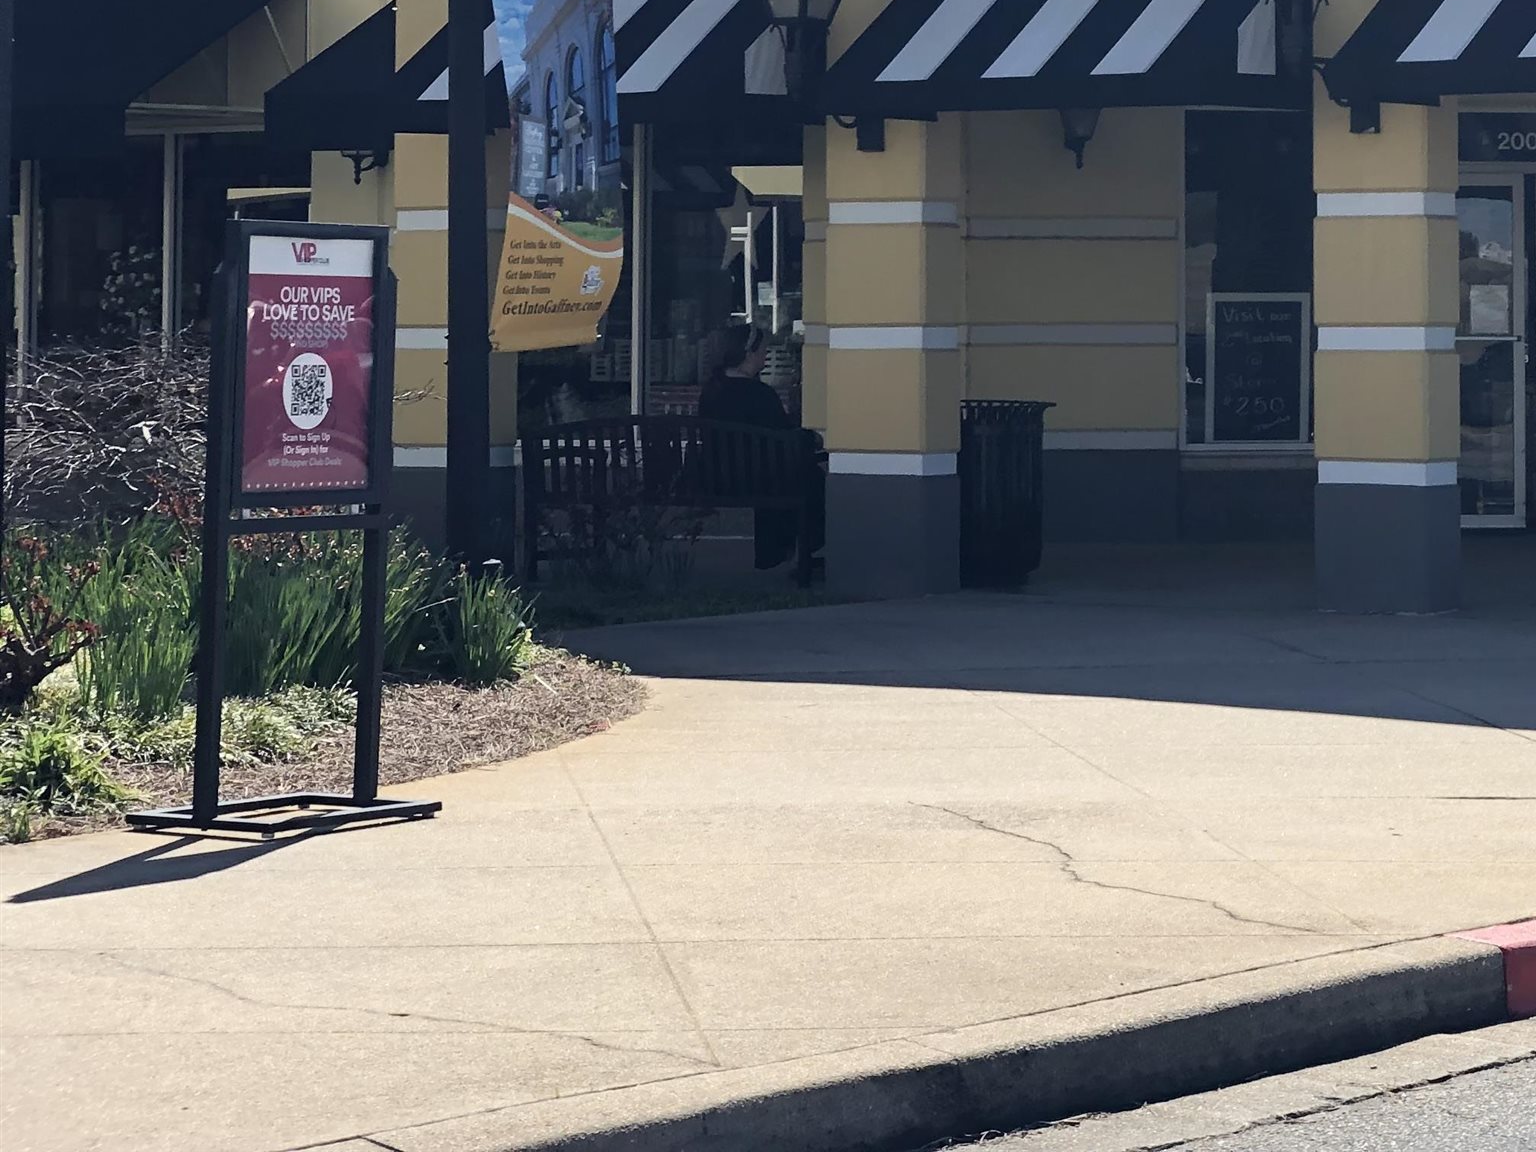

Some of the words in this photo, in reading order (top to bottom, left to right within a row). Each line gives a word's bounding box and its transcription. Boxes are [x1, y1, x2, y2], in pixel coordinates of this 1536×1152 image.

[291, 242, 317, 263] VIP
[280, 286, 309, 303] OUR
[310, 287, 341, 304] VIPS
[263, 304, 298, 320] LOVE
[299, 305, 320, 321] TO
[322, 305, 355, 321] SAVE
[282, 433, 298, 442] Scan
[307, 433, 321, 443] Sign
[321, 433, 331, 442] Up
[295, 445, 310, 456] Sign
